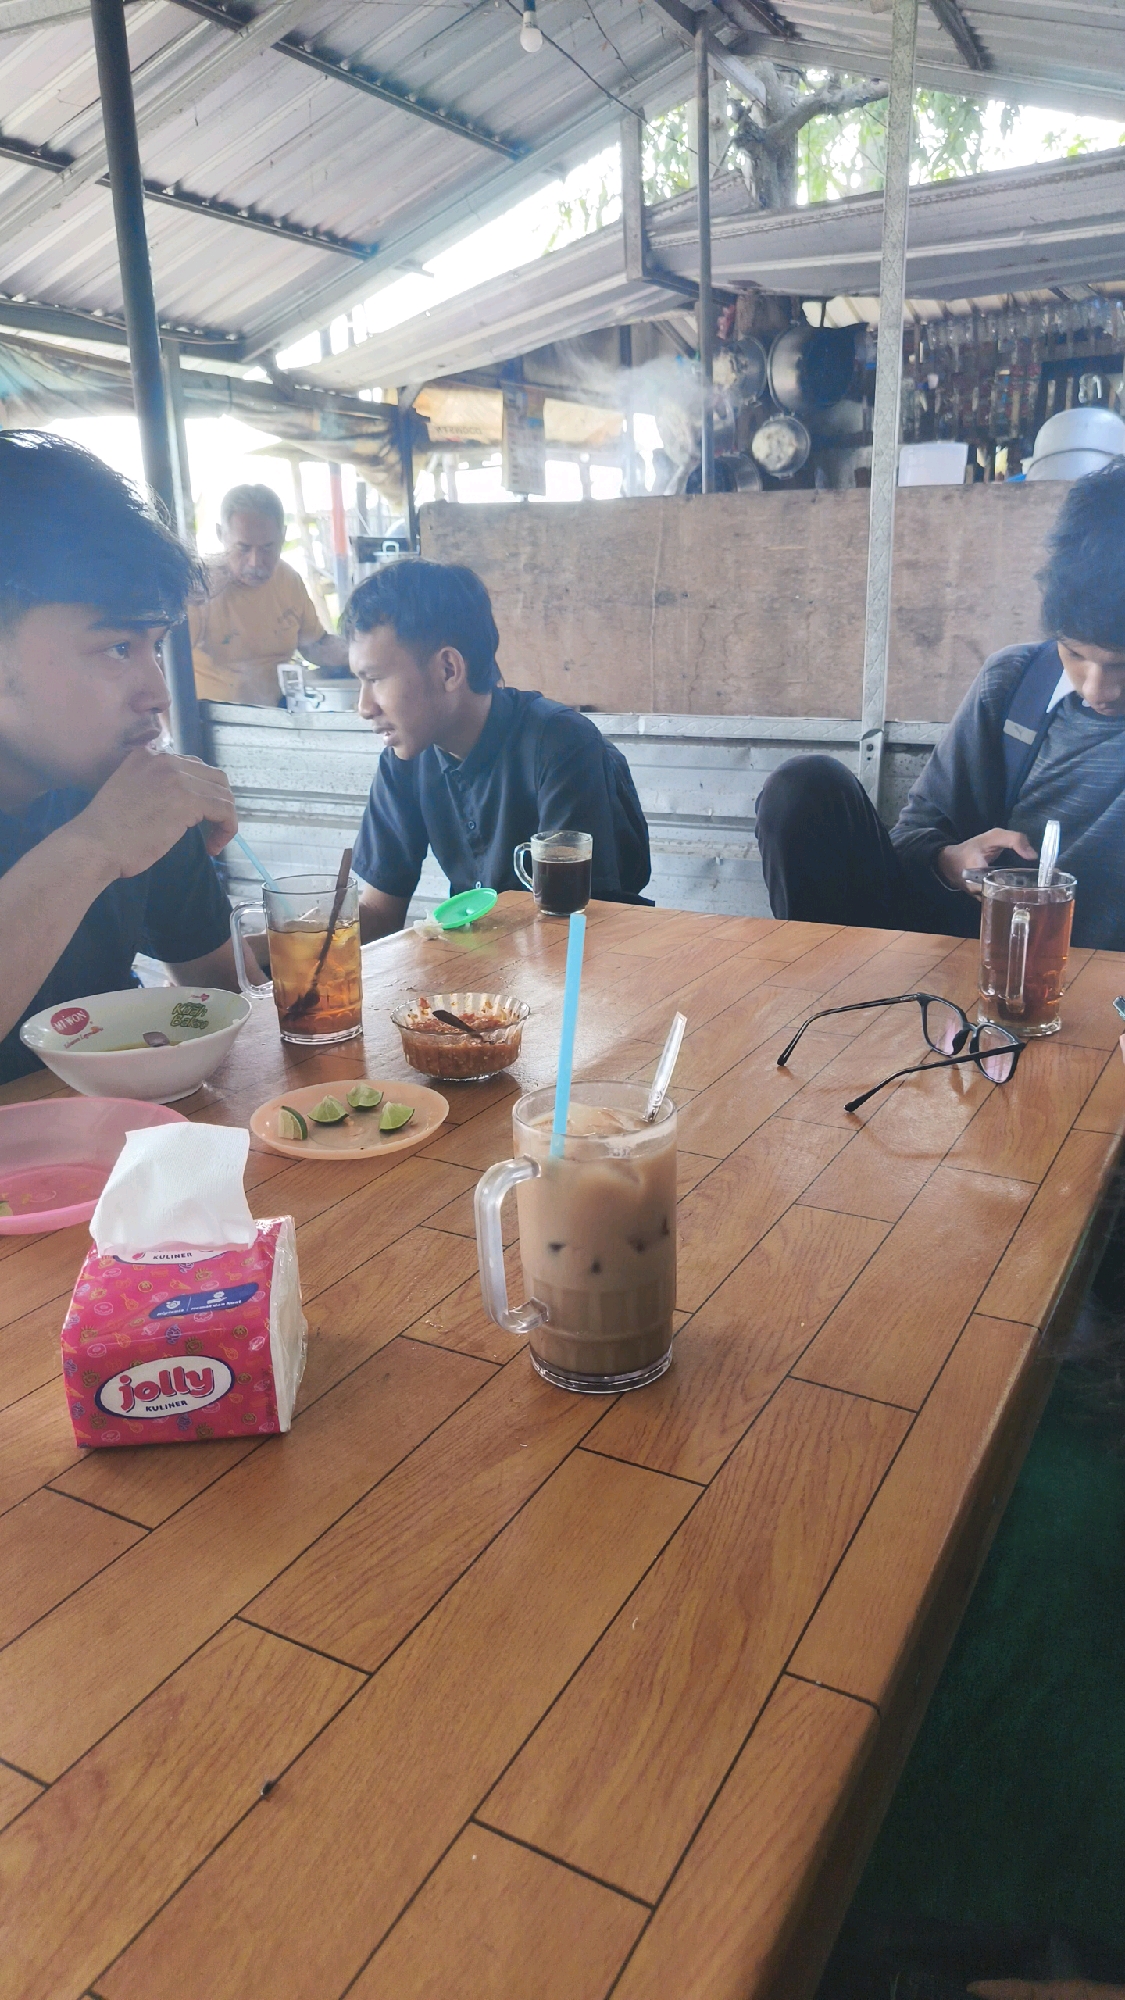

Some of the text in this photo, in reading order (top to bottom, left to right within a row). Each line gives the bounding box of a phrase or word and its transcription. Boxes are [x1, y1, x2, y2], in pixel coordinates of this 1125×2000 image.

[171, 1002, 208, 1017] Kuah
[153, 1252, 193, 1260] KULINER
[118, 1365, 215, 1413] jolly
[145, 1399, 189, 1412] KULINER
